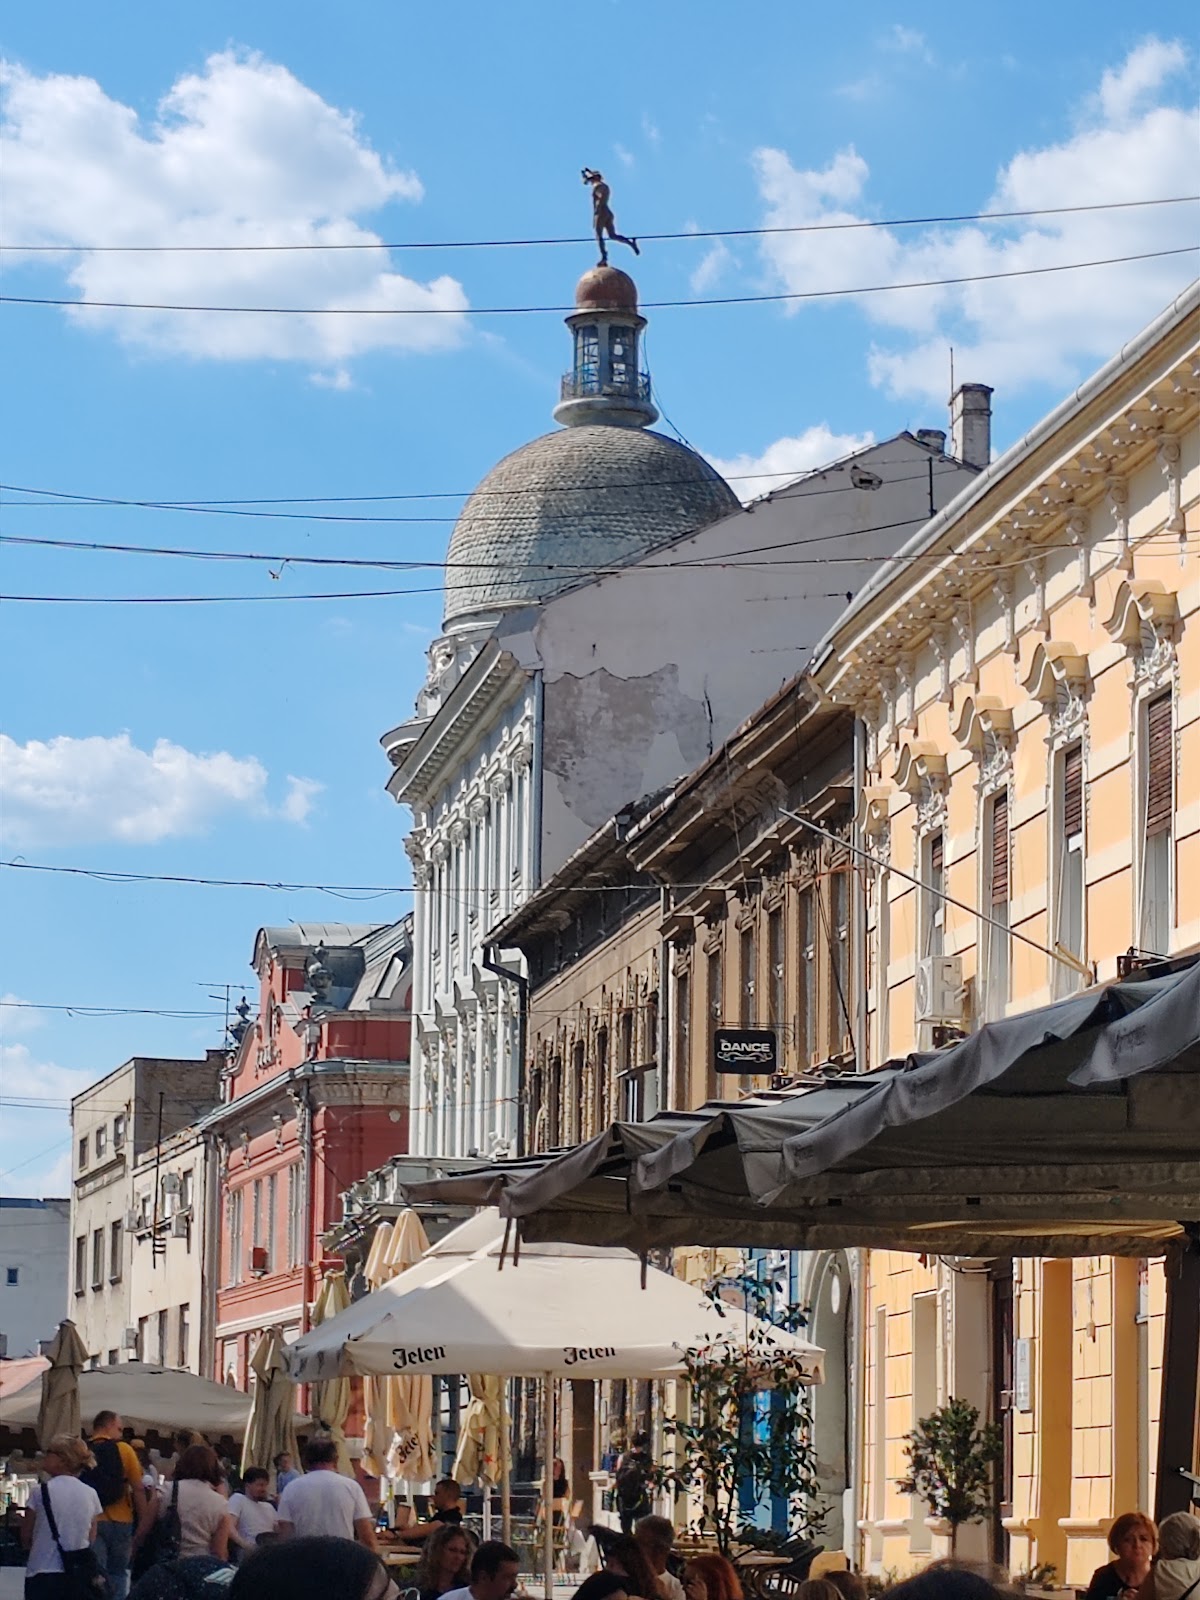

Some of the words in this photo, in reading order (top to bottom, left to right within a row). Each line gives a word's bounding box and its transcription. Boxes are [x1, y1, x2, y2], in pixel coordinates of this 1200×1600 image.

[721, 1042, 770, 1052] DANCE
[392, 1346, 446, 1369] Jelen
[563, 1346, 616, 1365] Jelen
